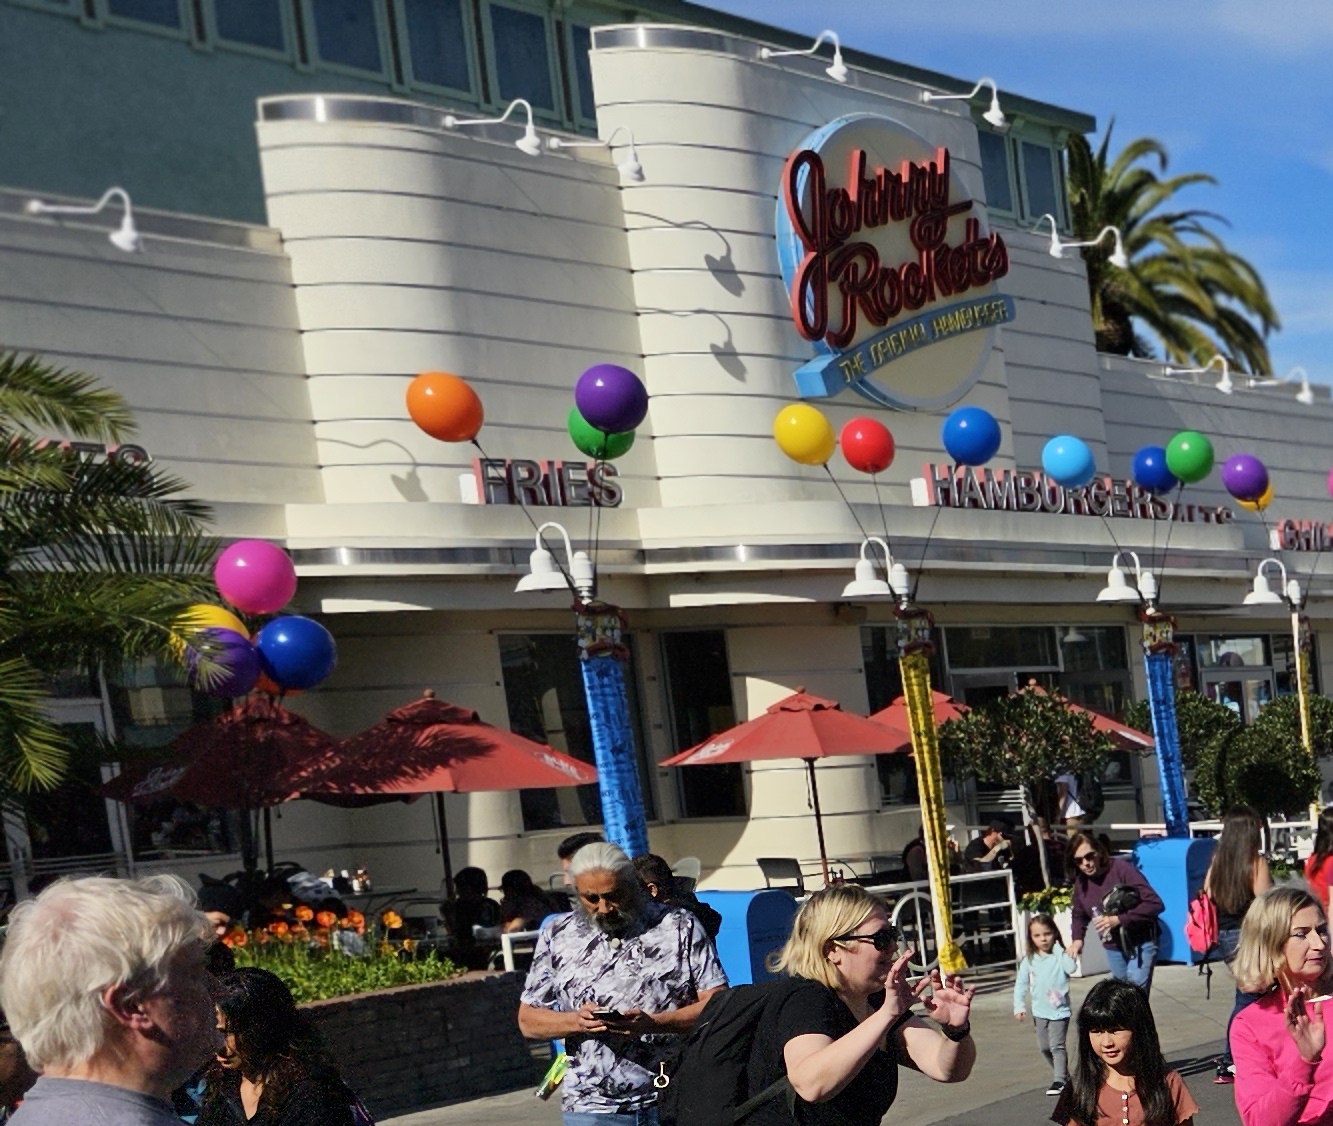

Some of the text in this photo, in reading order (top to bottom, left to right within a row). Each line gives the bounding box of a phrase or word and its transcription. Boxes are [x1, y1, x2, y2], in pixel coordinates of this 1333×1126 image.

[783, 147, 973, 252] Johnny
[790, 216, 1010, 348] Rockets
[839, 350, 867, 384] THE
[473, 457, 624, 507] FRIES
[922, 462, 1173, 520] HAMBURGERS
